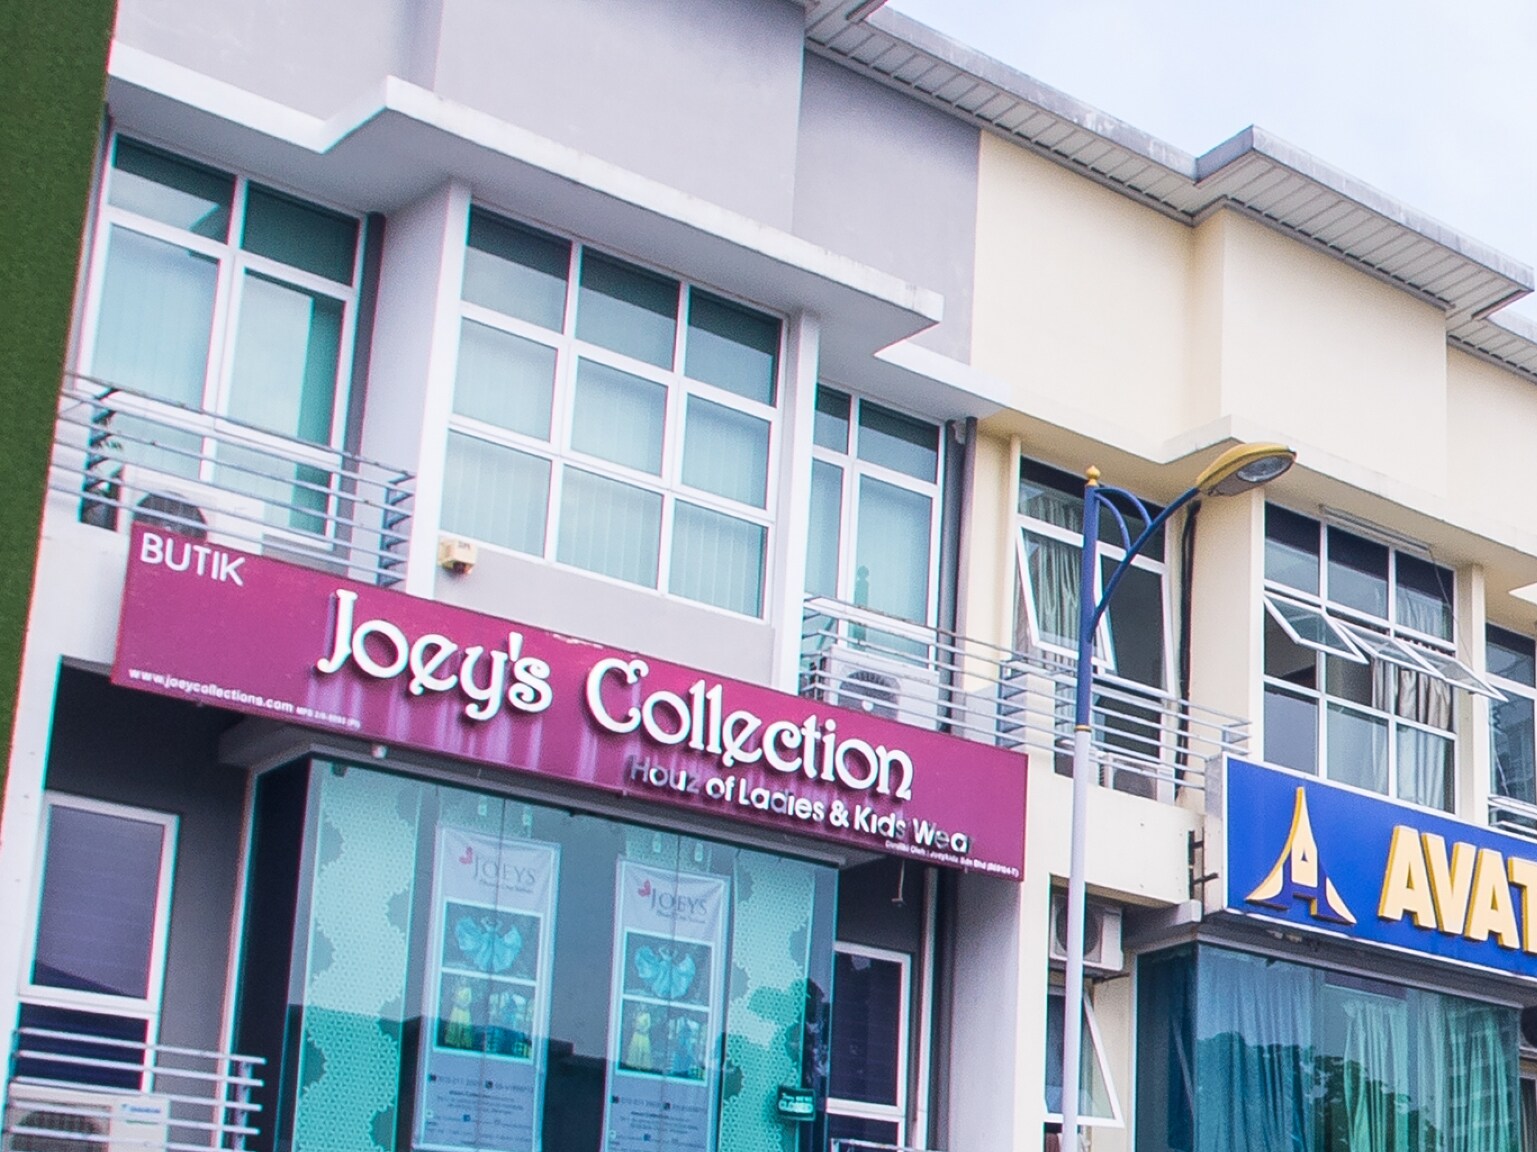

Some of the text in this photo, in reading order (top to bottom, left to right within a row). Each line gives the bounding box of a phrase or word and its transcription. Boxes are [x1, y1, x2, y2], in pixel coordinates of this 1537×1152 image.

[140, 532, 246, 586] BUTIK
[317, 588, 914, 800] Joey's Collection
[631, 755, 700, 794] Houz
[706, 776, 738, 800] of
[739, 778, 825, 822] Ladies
[829, 803, 849, 828] &
[854, 806, 906, 839] Kids
